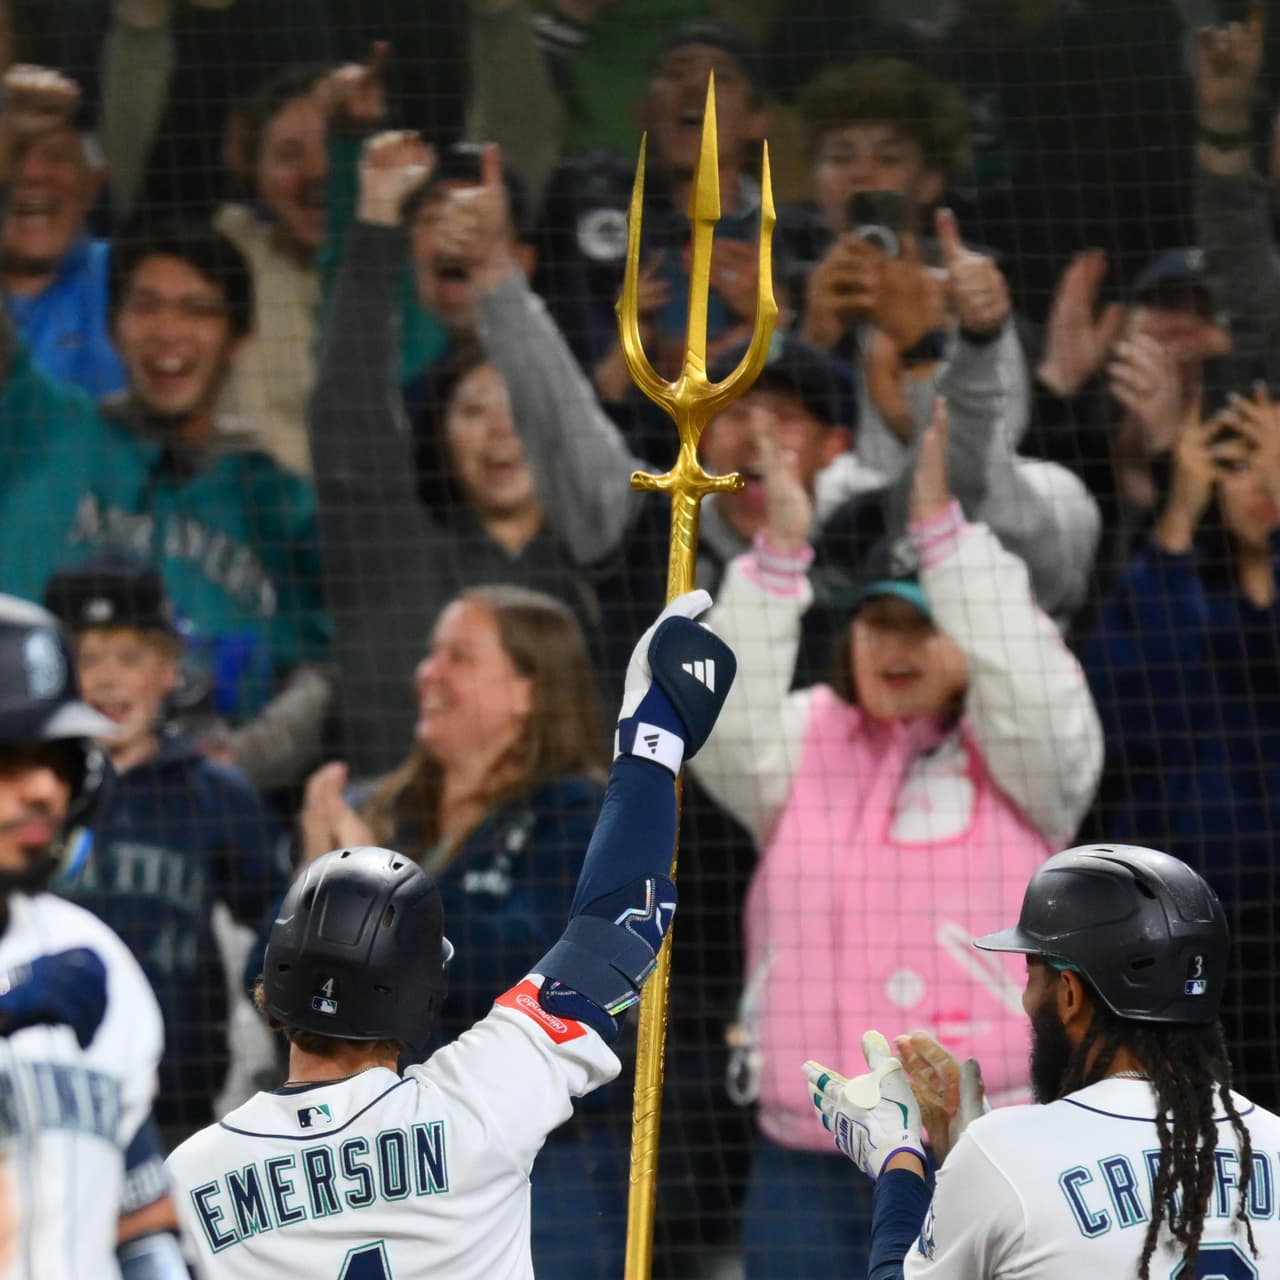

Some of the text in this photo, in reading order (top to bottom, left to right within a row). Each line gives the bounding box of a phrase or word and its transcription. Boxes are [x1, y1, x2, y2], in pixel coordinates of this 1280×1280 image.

[1192, 954, 1204, 978] 3
[321, 977, 334, 997] 4
[190, 1120, 449, 1255] EMERSON
